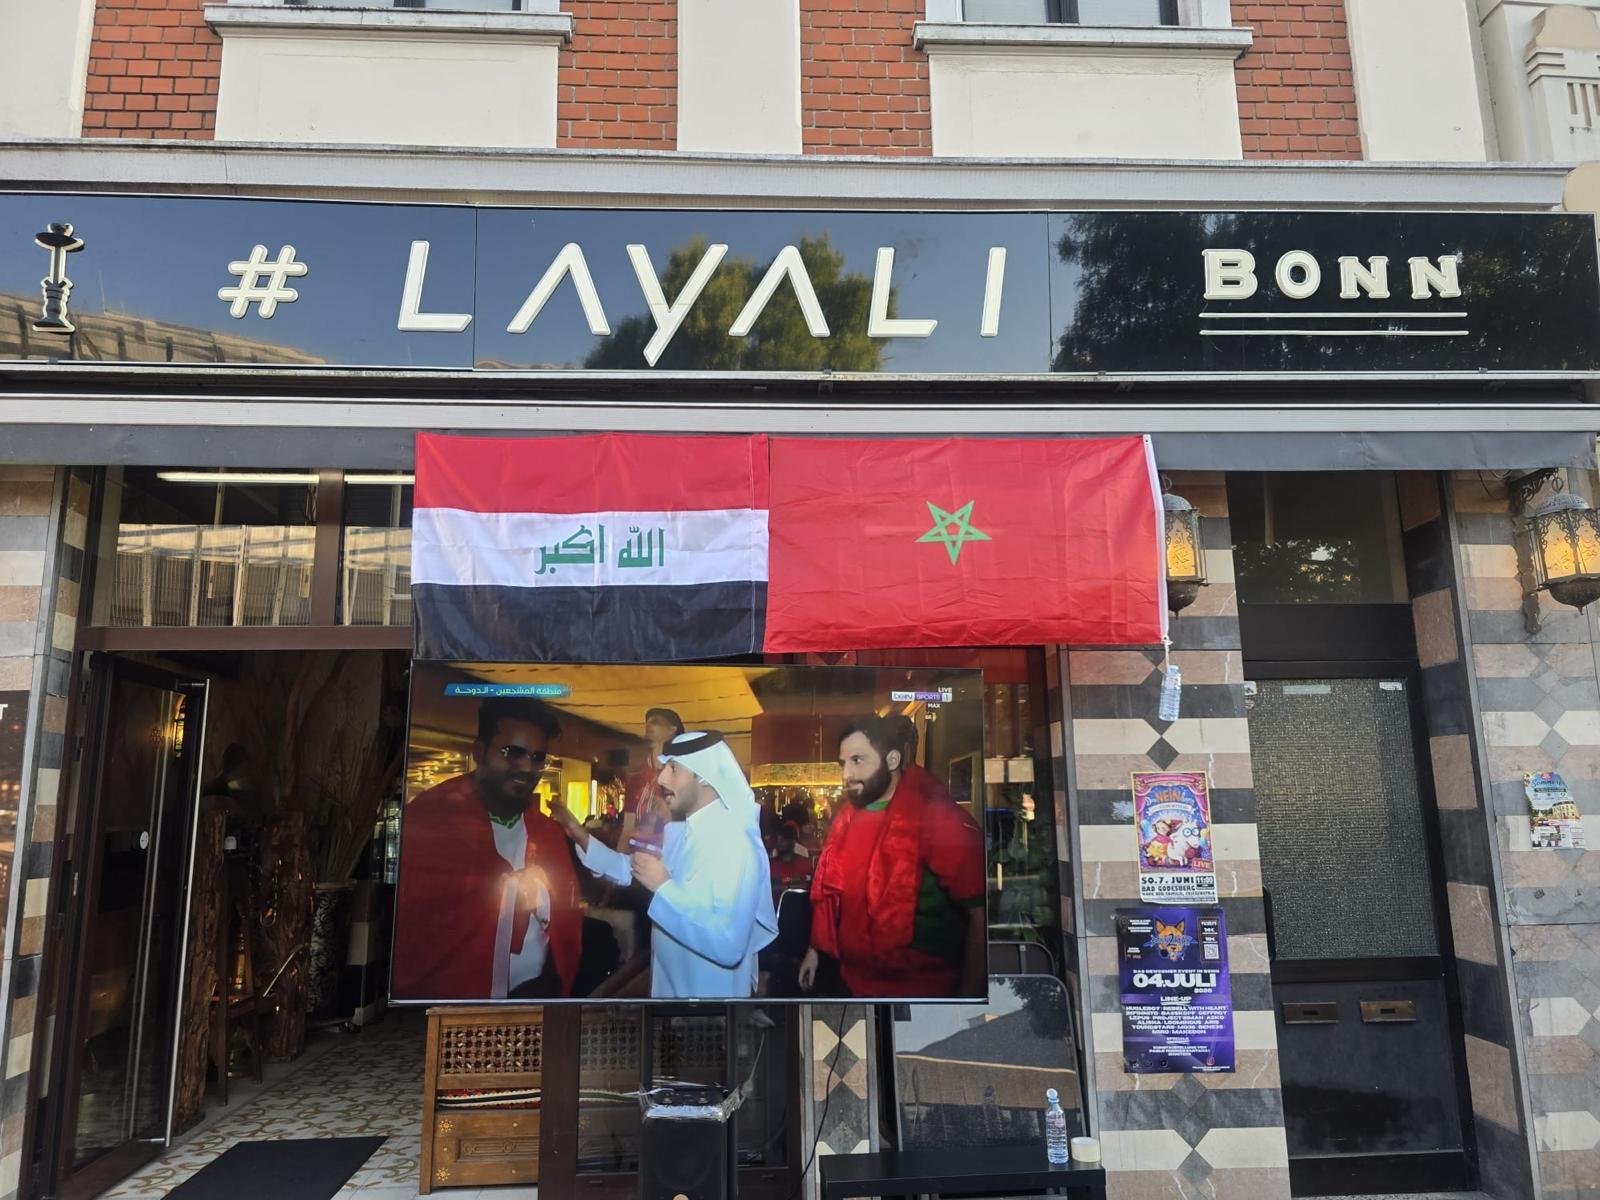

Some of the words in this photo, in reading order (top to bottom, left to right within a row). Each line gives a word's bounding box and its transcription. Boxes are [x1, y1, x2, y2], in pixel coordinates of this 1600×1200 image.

[397, 239, 1007, 367] LAYALI
[1201, 248, 1462, 300] BONN
[617, 525, 665, 568] الله
[1172, 876, 1195, 884] JUNI
[1133, 973, 1216, 988] 04.JULI
